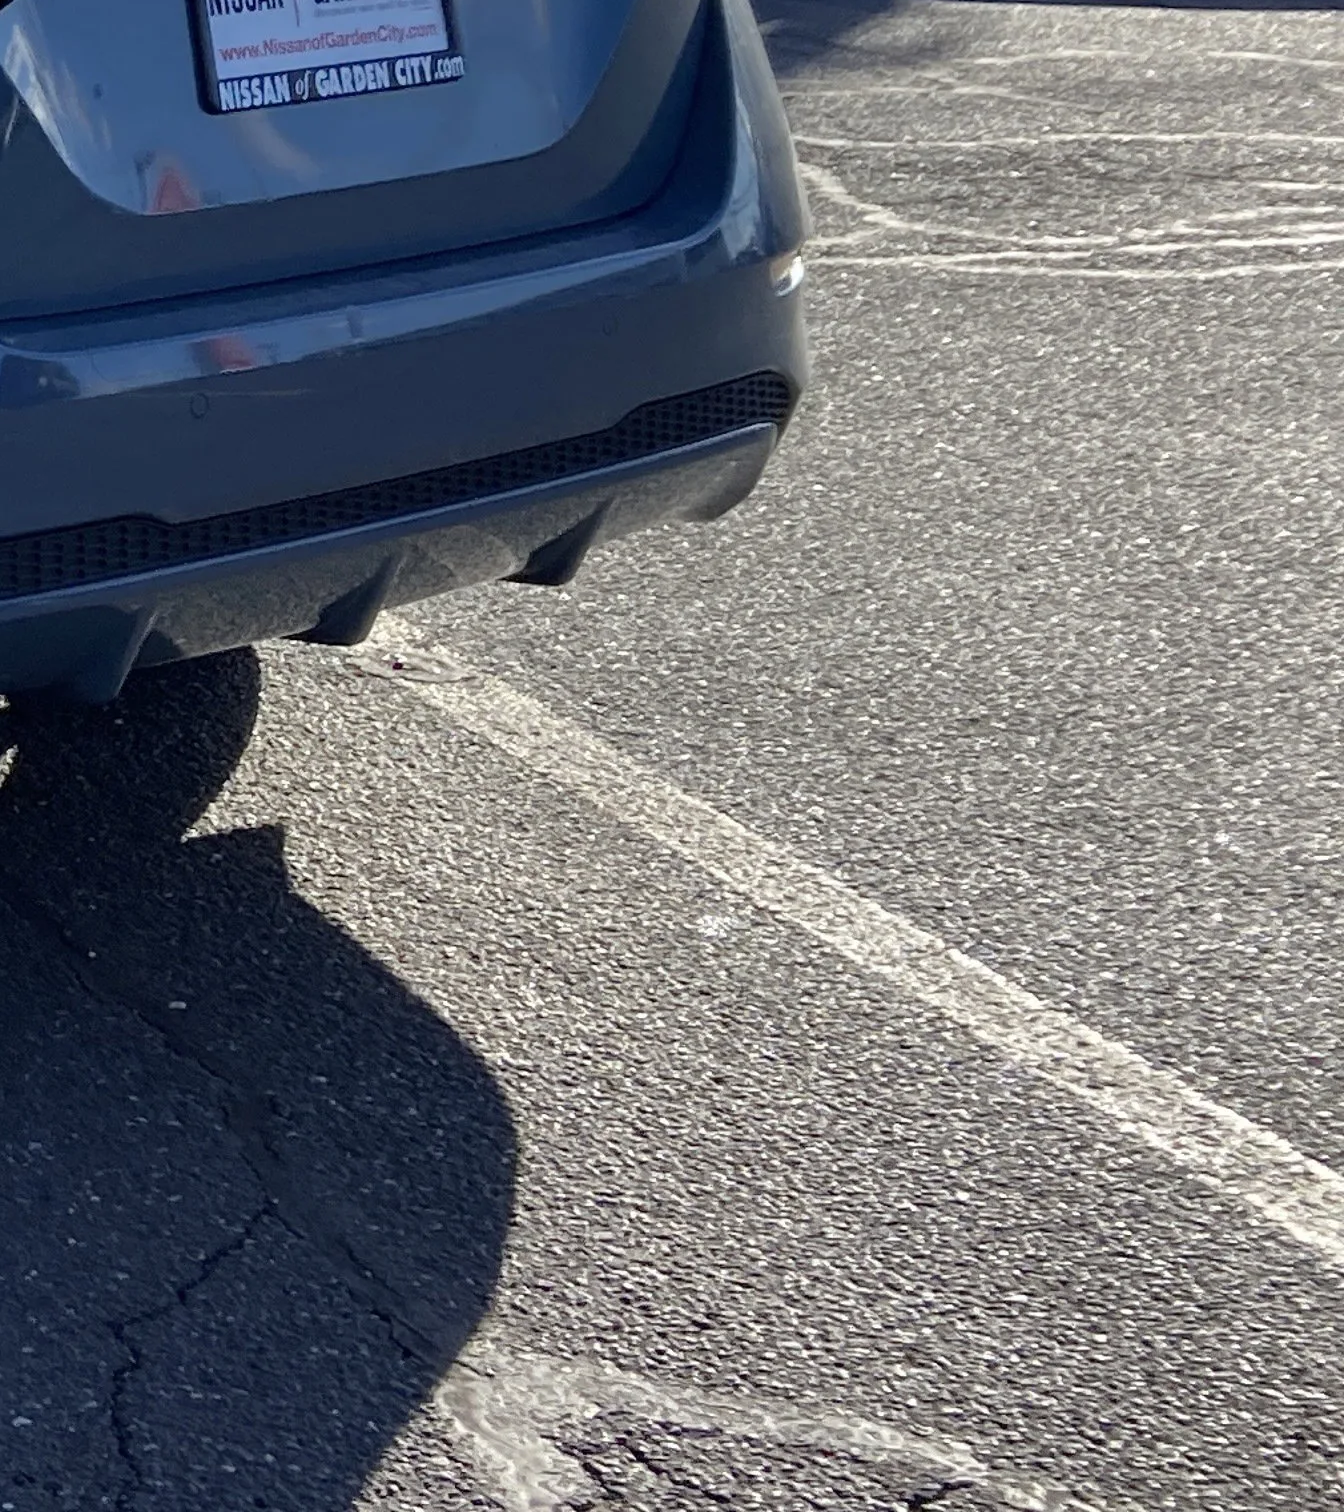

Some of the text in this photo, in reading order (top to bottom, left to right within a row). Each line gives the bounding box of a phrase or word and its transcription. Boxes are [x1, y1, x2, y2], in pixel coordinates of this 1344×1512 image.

[218, 23, 438, 62] www.NissanofGardenCity.com
[219, 74, 291, 112] NISSAN
[295, 70, 312, 101] of
[315, 61, 391, 98] GARDEN
